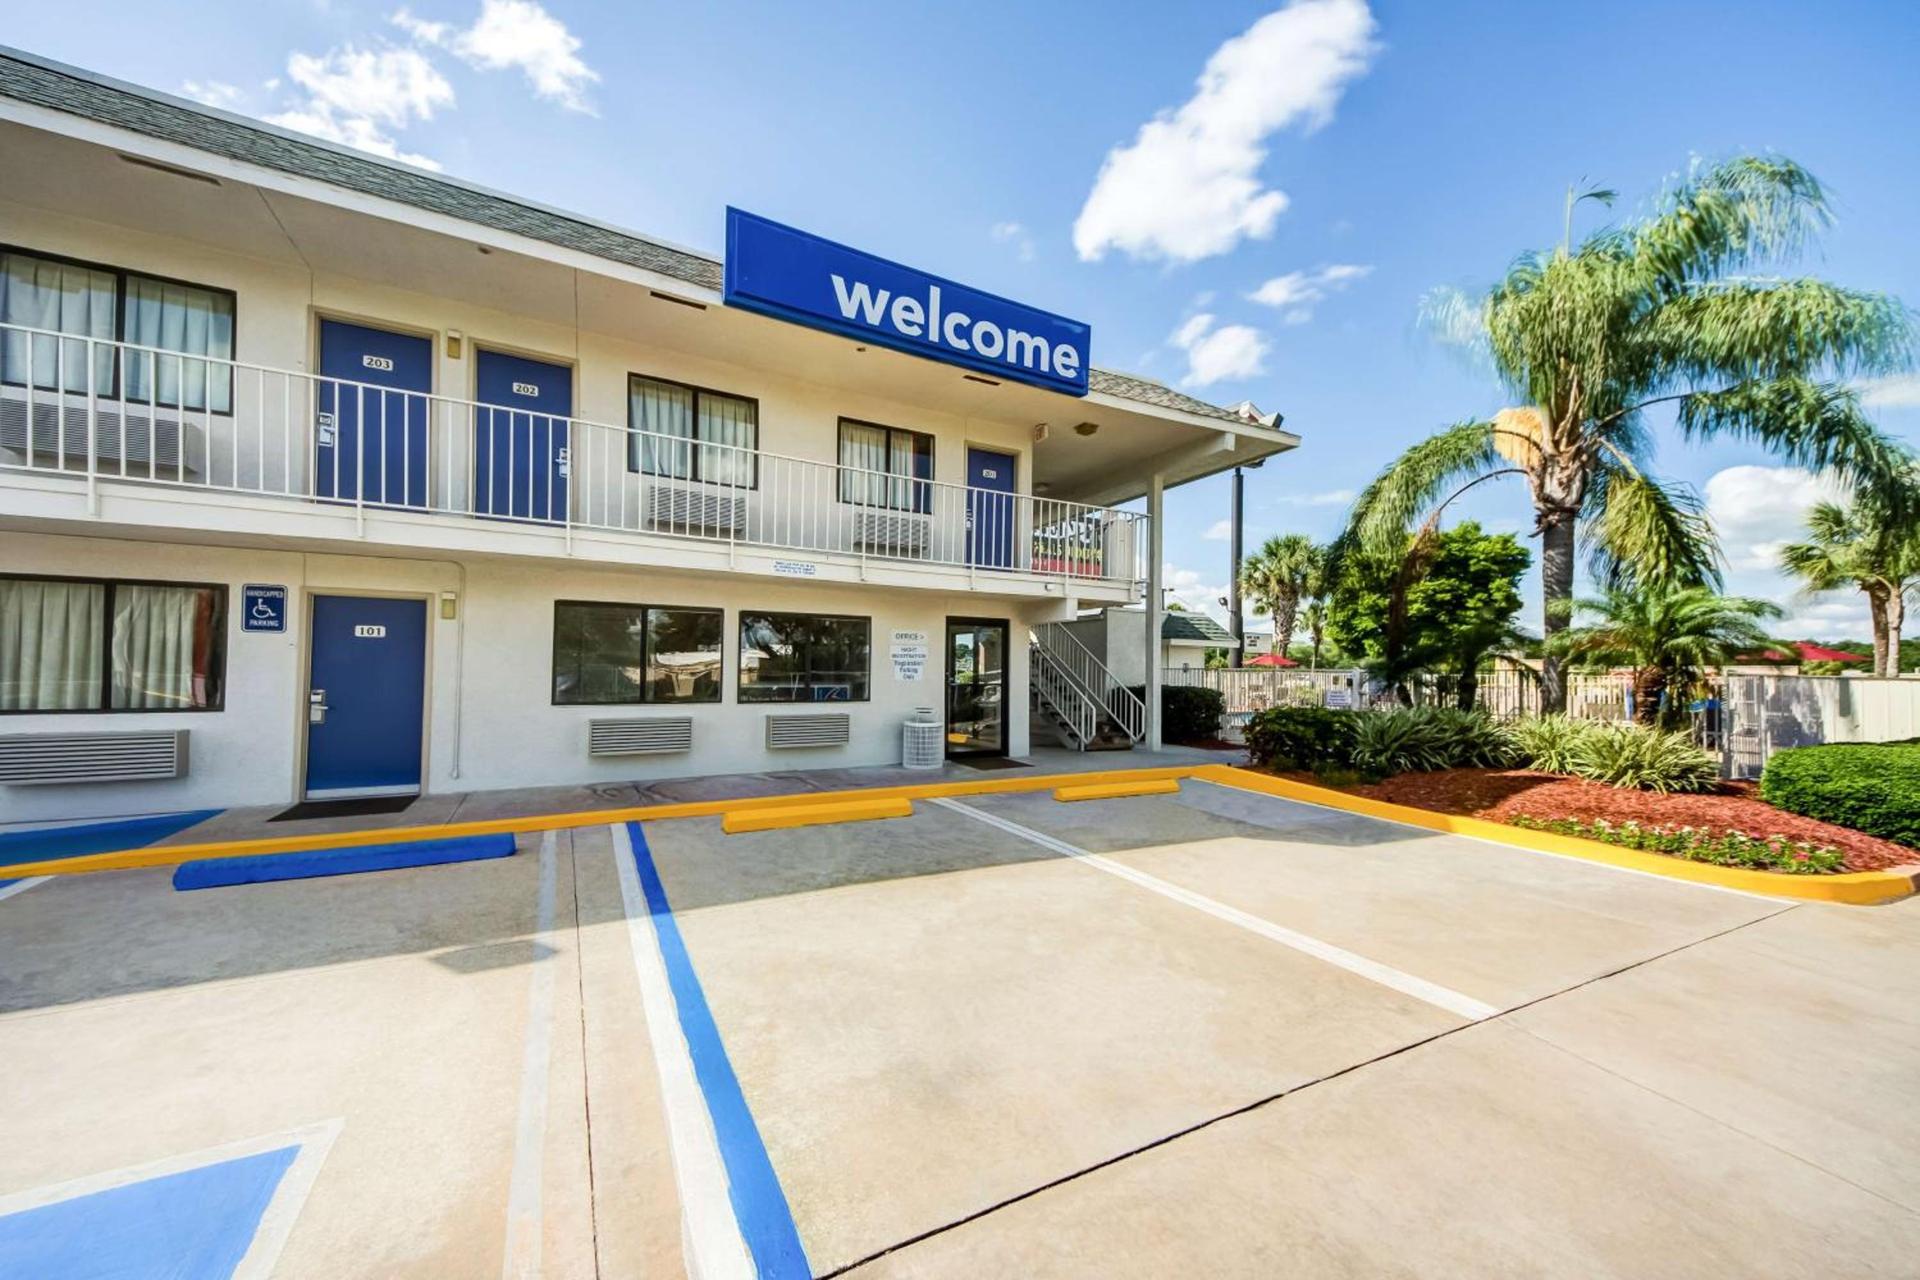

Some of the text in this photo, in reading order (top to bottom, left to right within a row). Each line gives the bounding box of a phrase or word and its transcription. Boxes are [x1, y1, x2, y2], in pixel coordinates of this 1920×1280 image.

[830, 274, 1080, 379] welcome
[366, 357, 391, 369] 203
[515, 384, 537, 395] 202
[246, 590, 284, 599] HANDICAPPED
[249, 619, 279, 627] PARKING
[359, 627, 382, 636] 101
[895, 632, 918, 641] OFFICE
